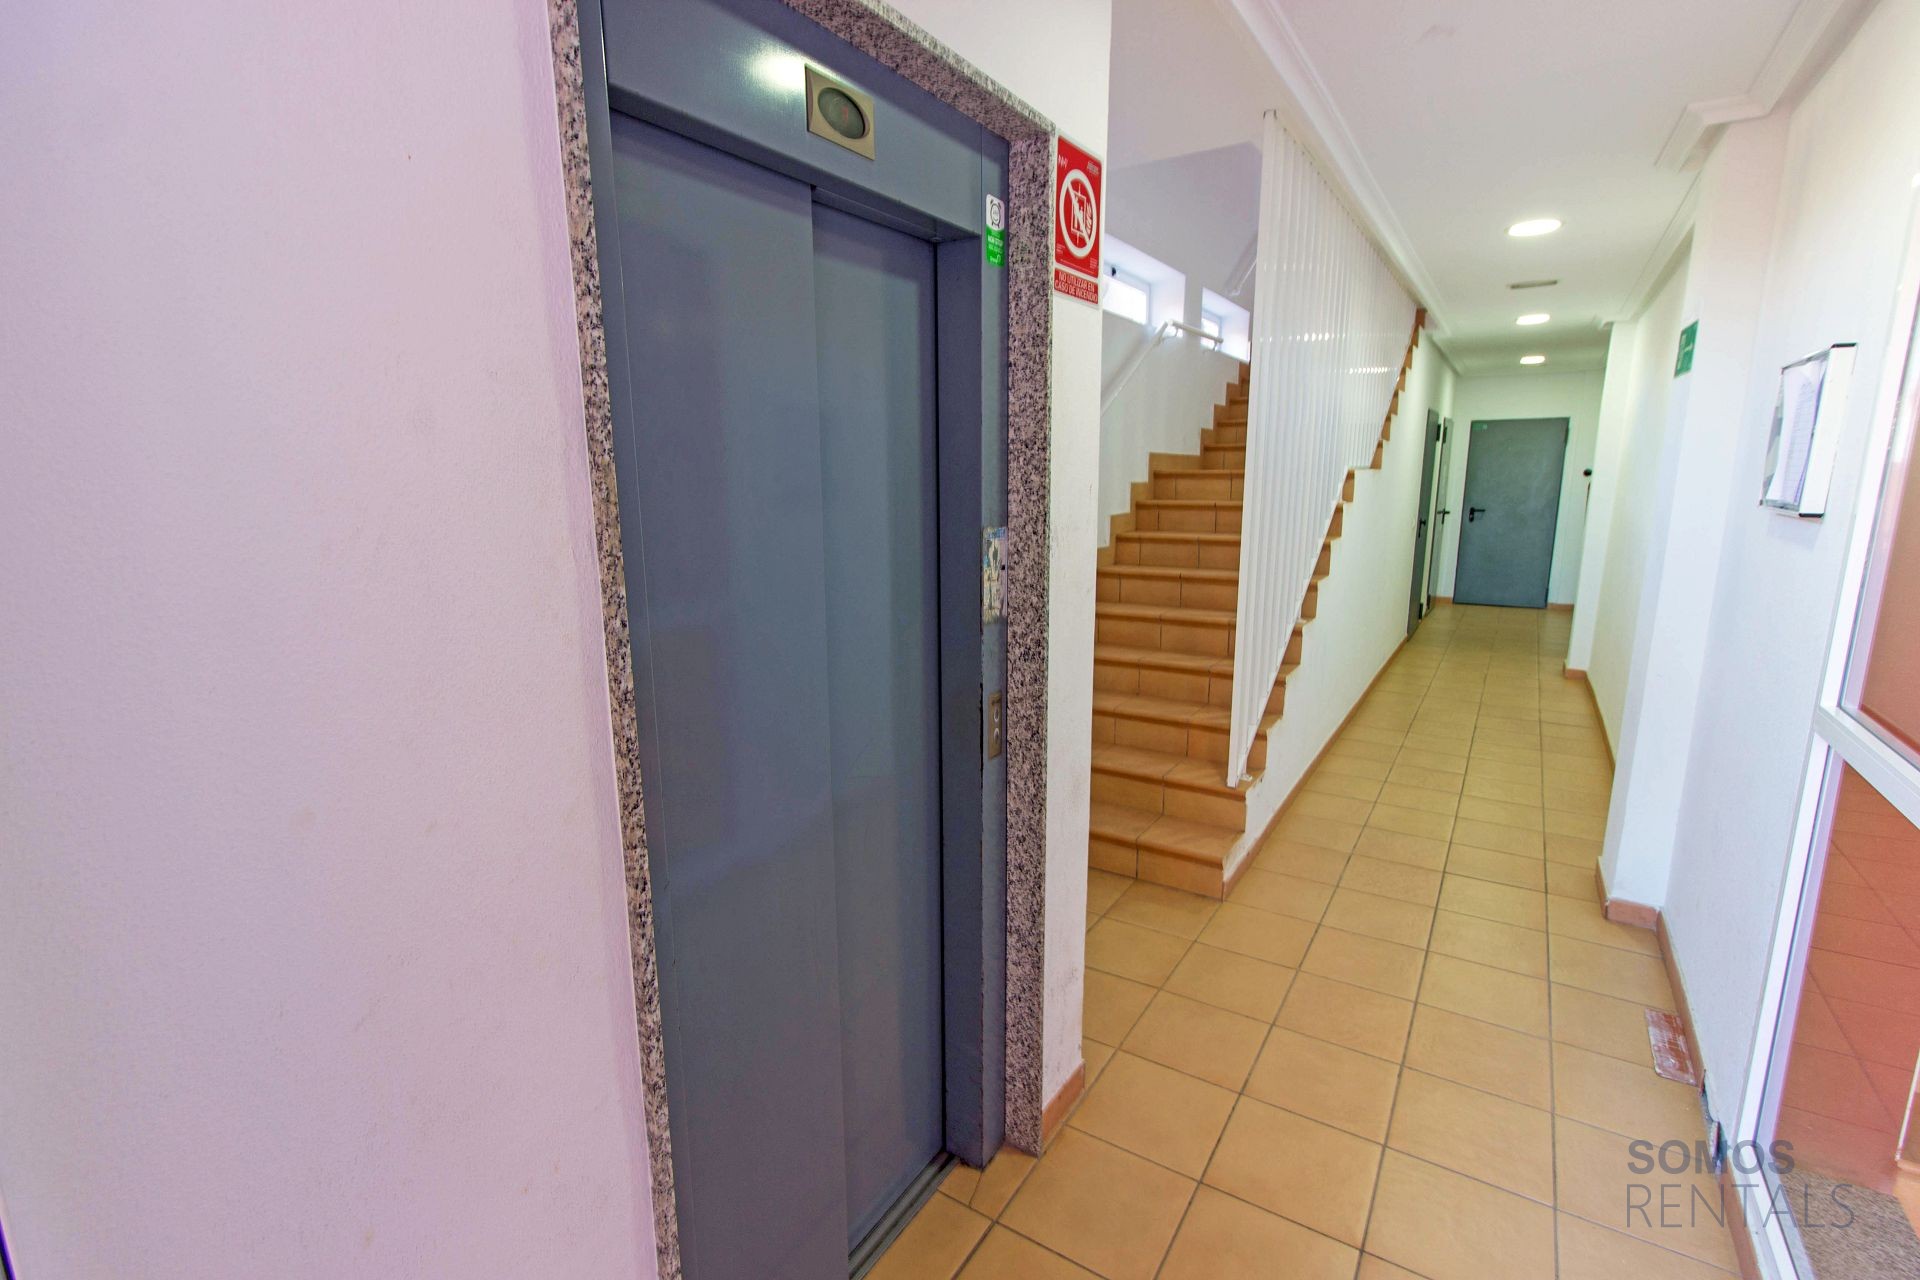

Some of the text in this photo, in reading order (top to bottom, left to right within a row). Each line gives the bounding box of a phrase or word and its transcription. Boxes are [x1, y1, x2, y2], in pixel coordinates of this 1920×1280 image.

[1055, 279, 1069, 292] CASO
[1069, 285, 1076, 295] DE
[1059, 271, 1095, 293] NO UTILIZAR EN
